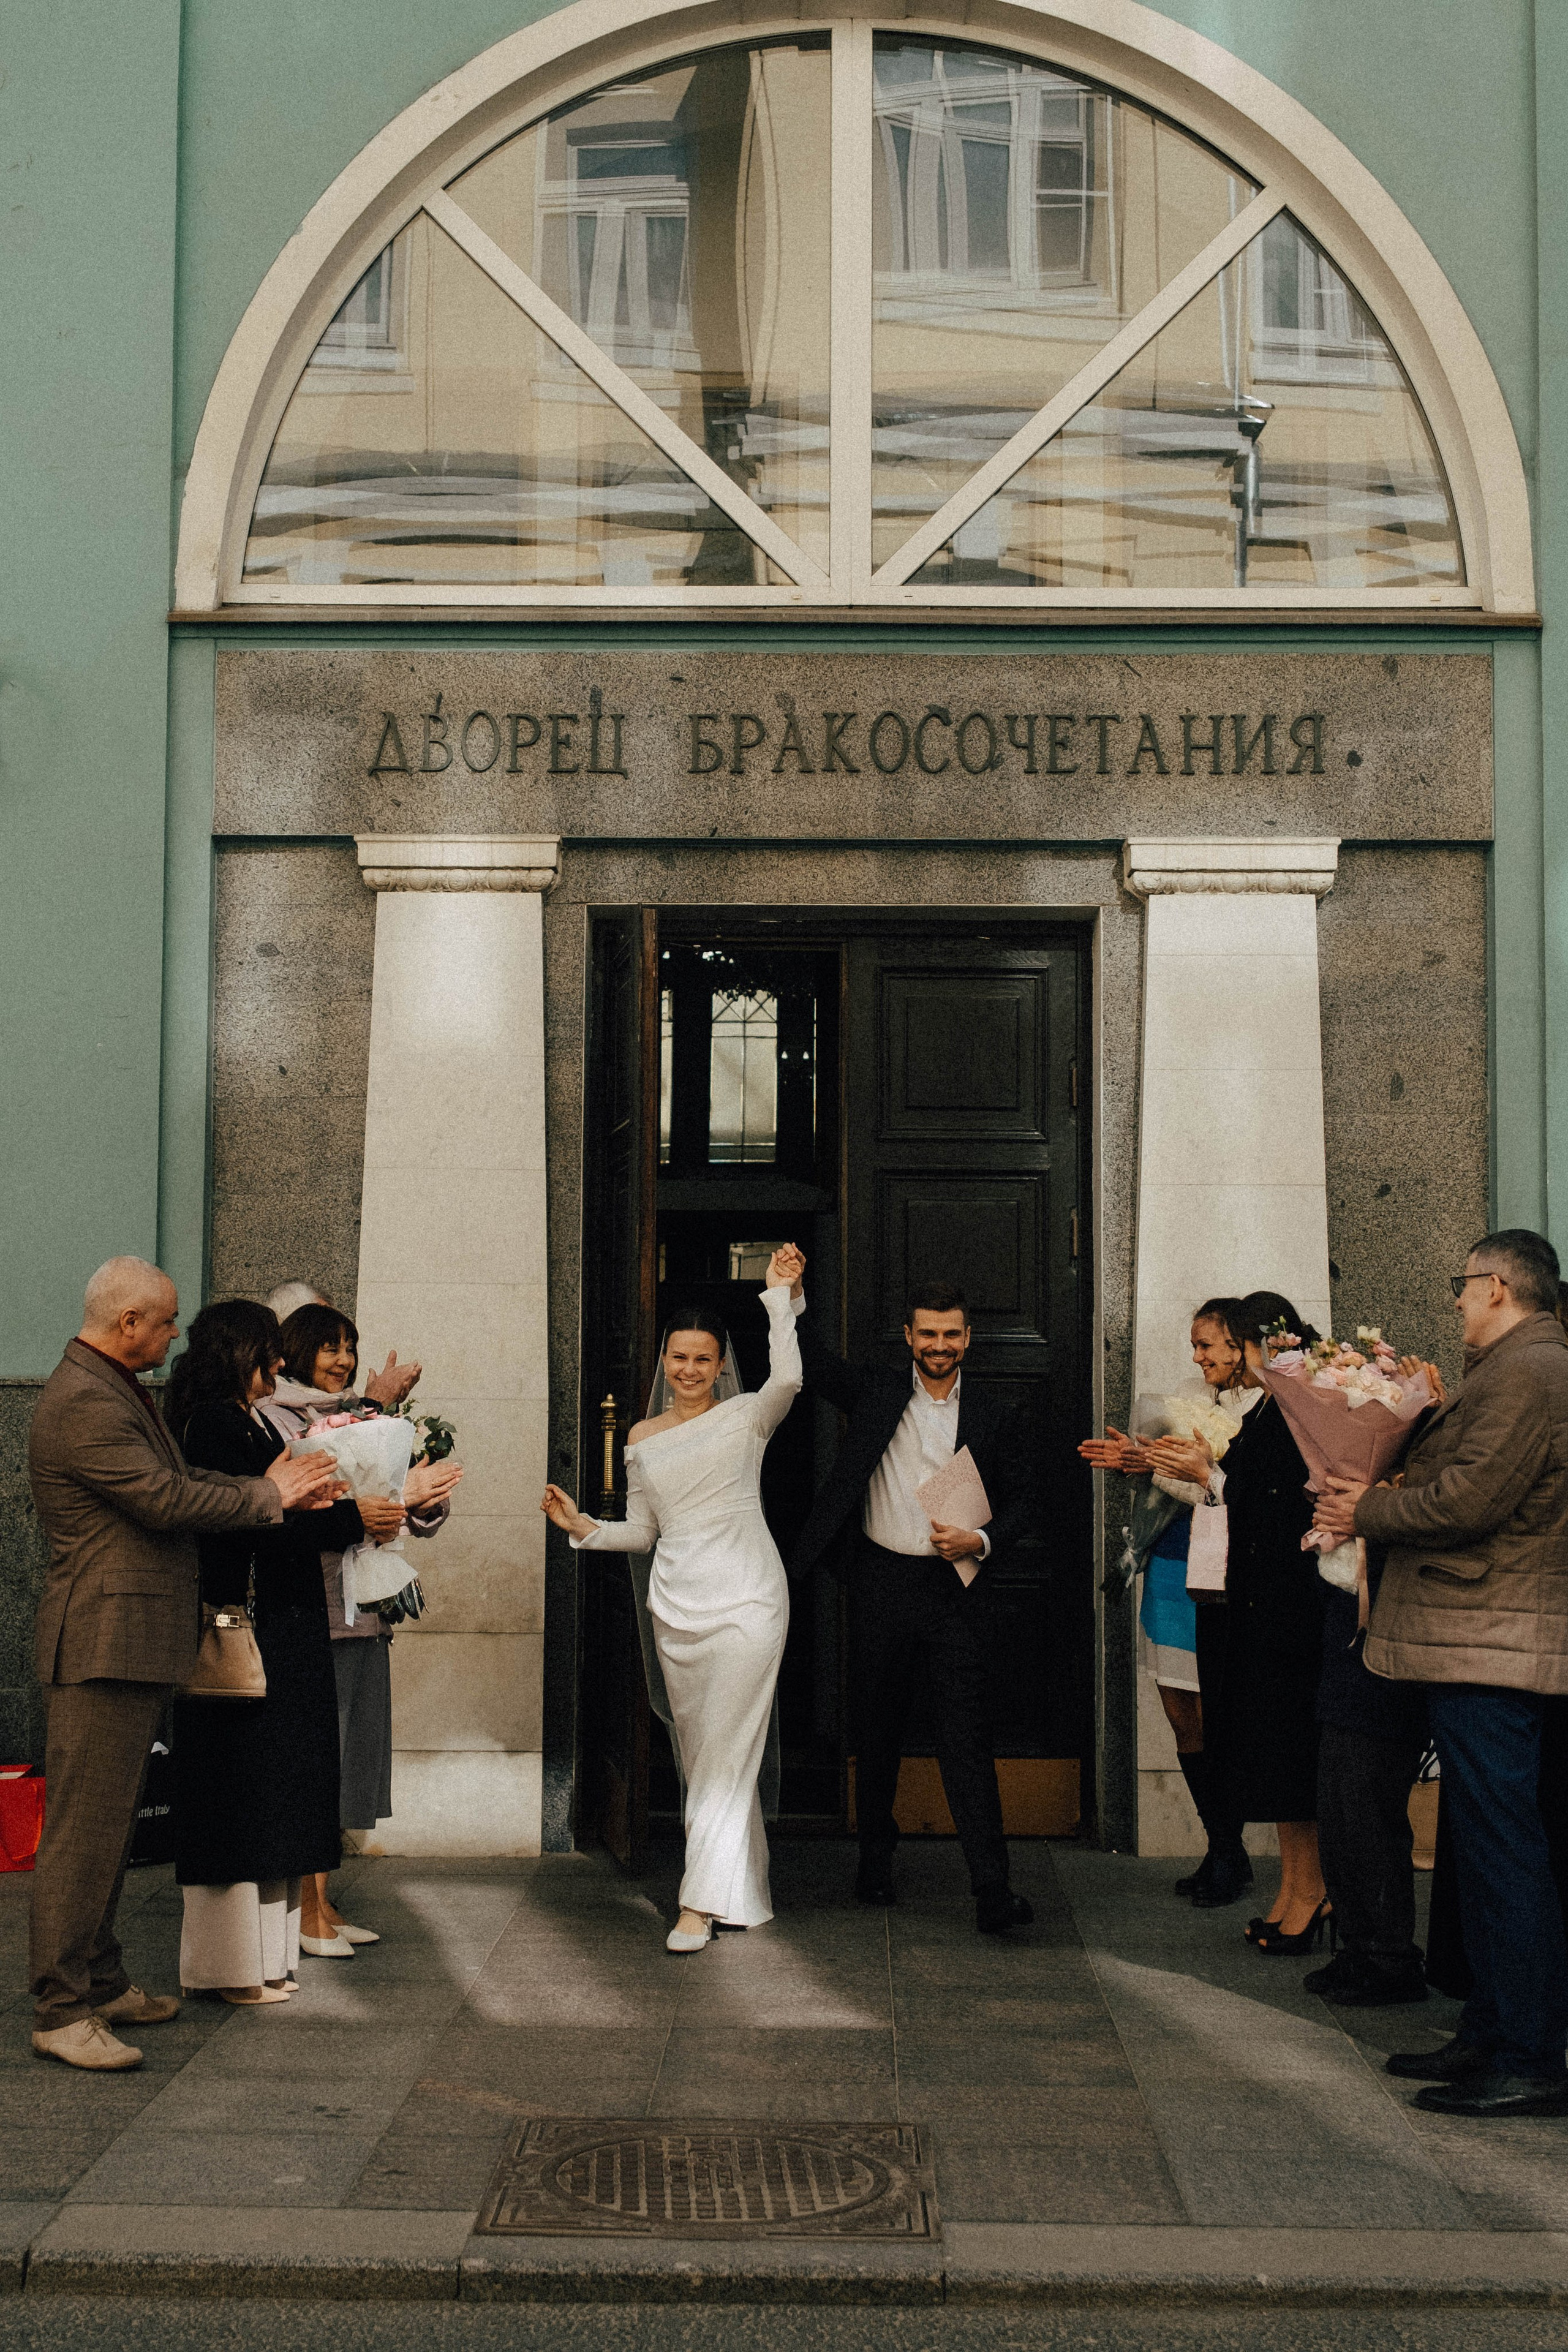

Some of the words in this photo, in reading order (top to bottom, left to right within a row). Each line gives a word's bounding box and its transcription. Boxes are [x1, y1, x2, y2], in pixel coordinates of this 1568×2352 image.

[369, 709, 628, 779] ДВОРЕЦ
[688, 710, 1325, 776] БРАКОСОЧЕТАНИЯ
[138, 1806, 153, 1818] ittle
[155, 1804, 170, 1816] Italy
